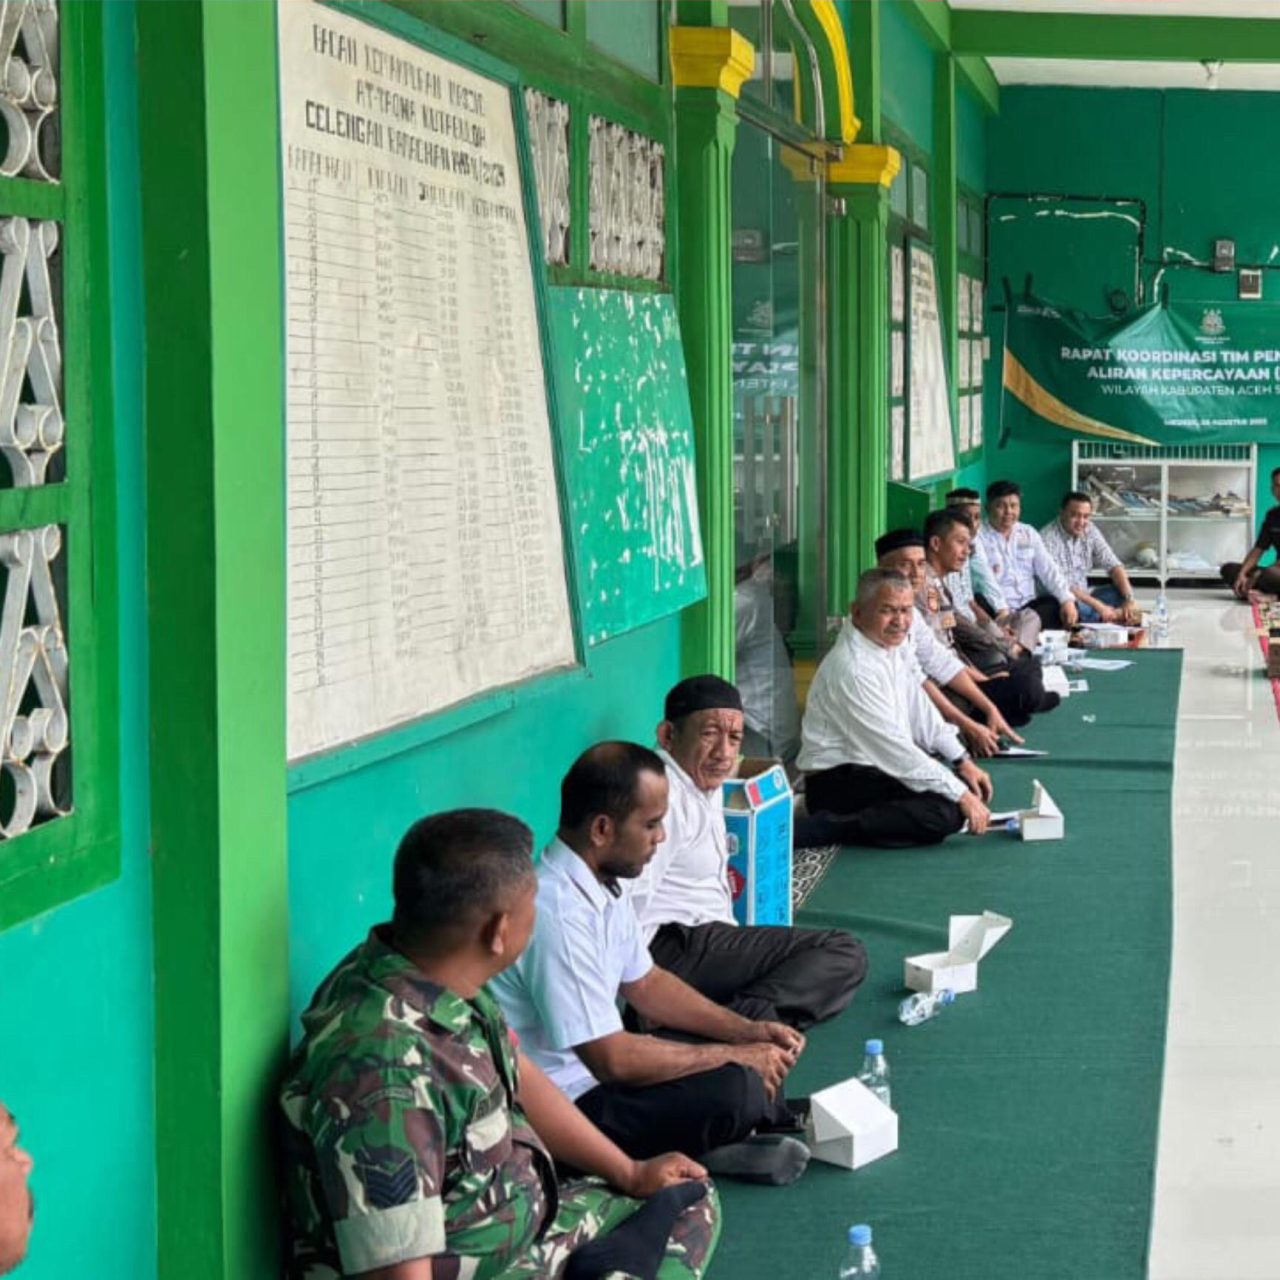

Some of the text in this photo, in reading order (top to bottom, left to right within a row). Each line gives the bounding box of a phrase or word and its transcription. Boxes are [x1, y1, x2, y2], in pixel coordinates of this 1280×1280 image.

[1060, 346, 1112, 361] RAPAT
[1116, 348, 1217, 364] KOORDINASI
[1221, 349, 1249, 363] TIM
[1087, 366, 1148, 380] ALIRAN
[1151, 368, 1270, 381] KEPERCAYAAN
[1238, 384, 1272, 396] ACEH
